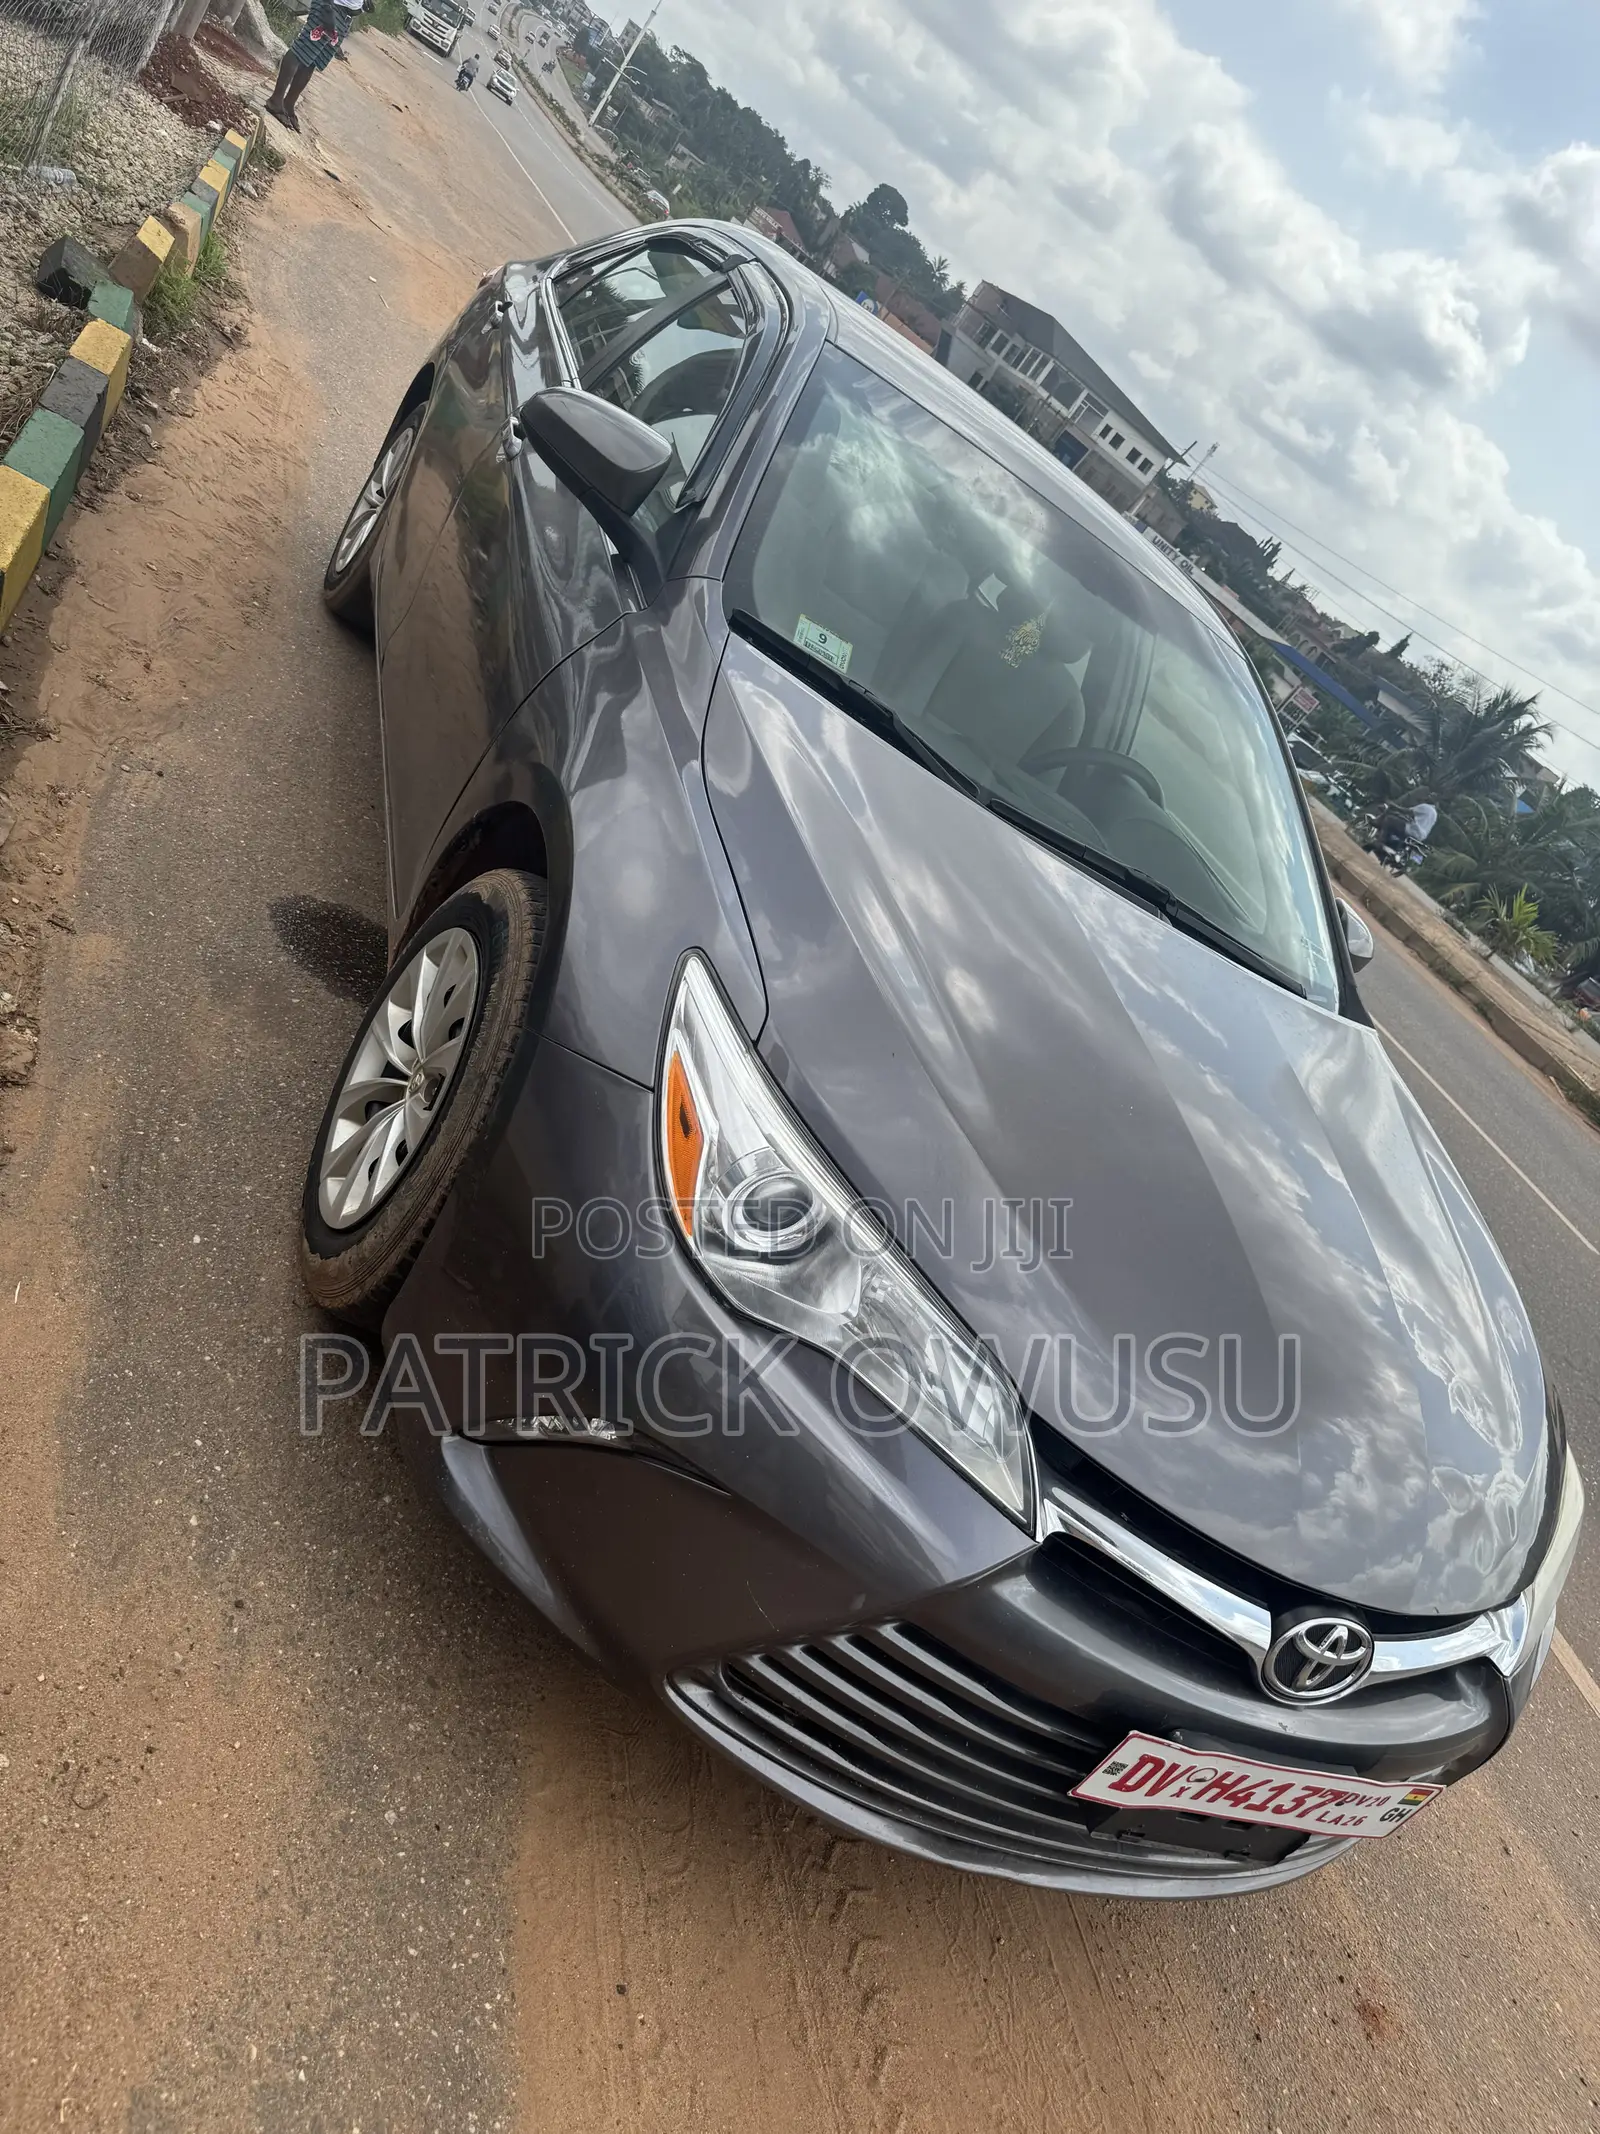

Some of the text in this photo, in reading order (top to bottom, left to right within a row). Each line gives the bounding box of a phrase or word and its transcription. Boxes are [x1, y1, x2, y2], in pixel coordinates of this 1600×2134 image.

[1152, 535, 1194, 575] UNITY OIL
[818, 632, 828, 644] 9
[1108, 1753, 1197, 1797] DV
[1189, 1770, 1349, 1819] H4137
[1315, 1810, 1368, 1827] LA26
[1379, 1807, 1412, 1823] GH
